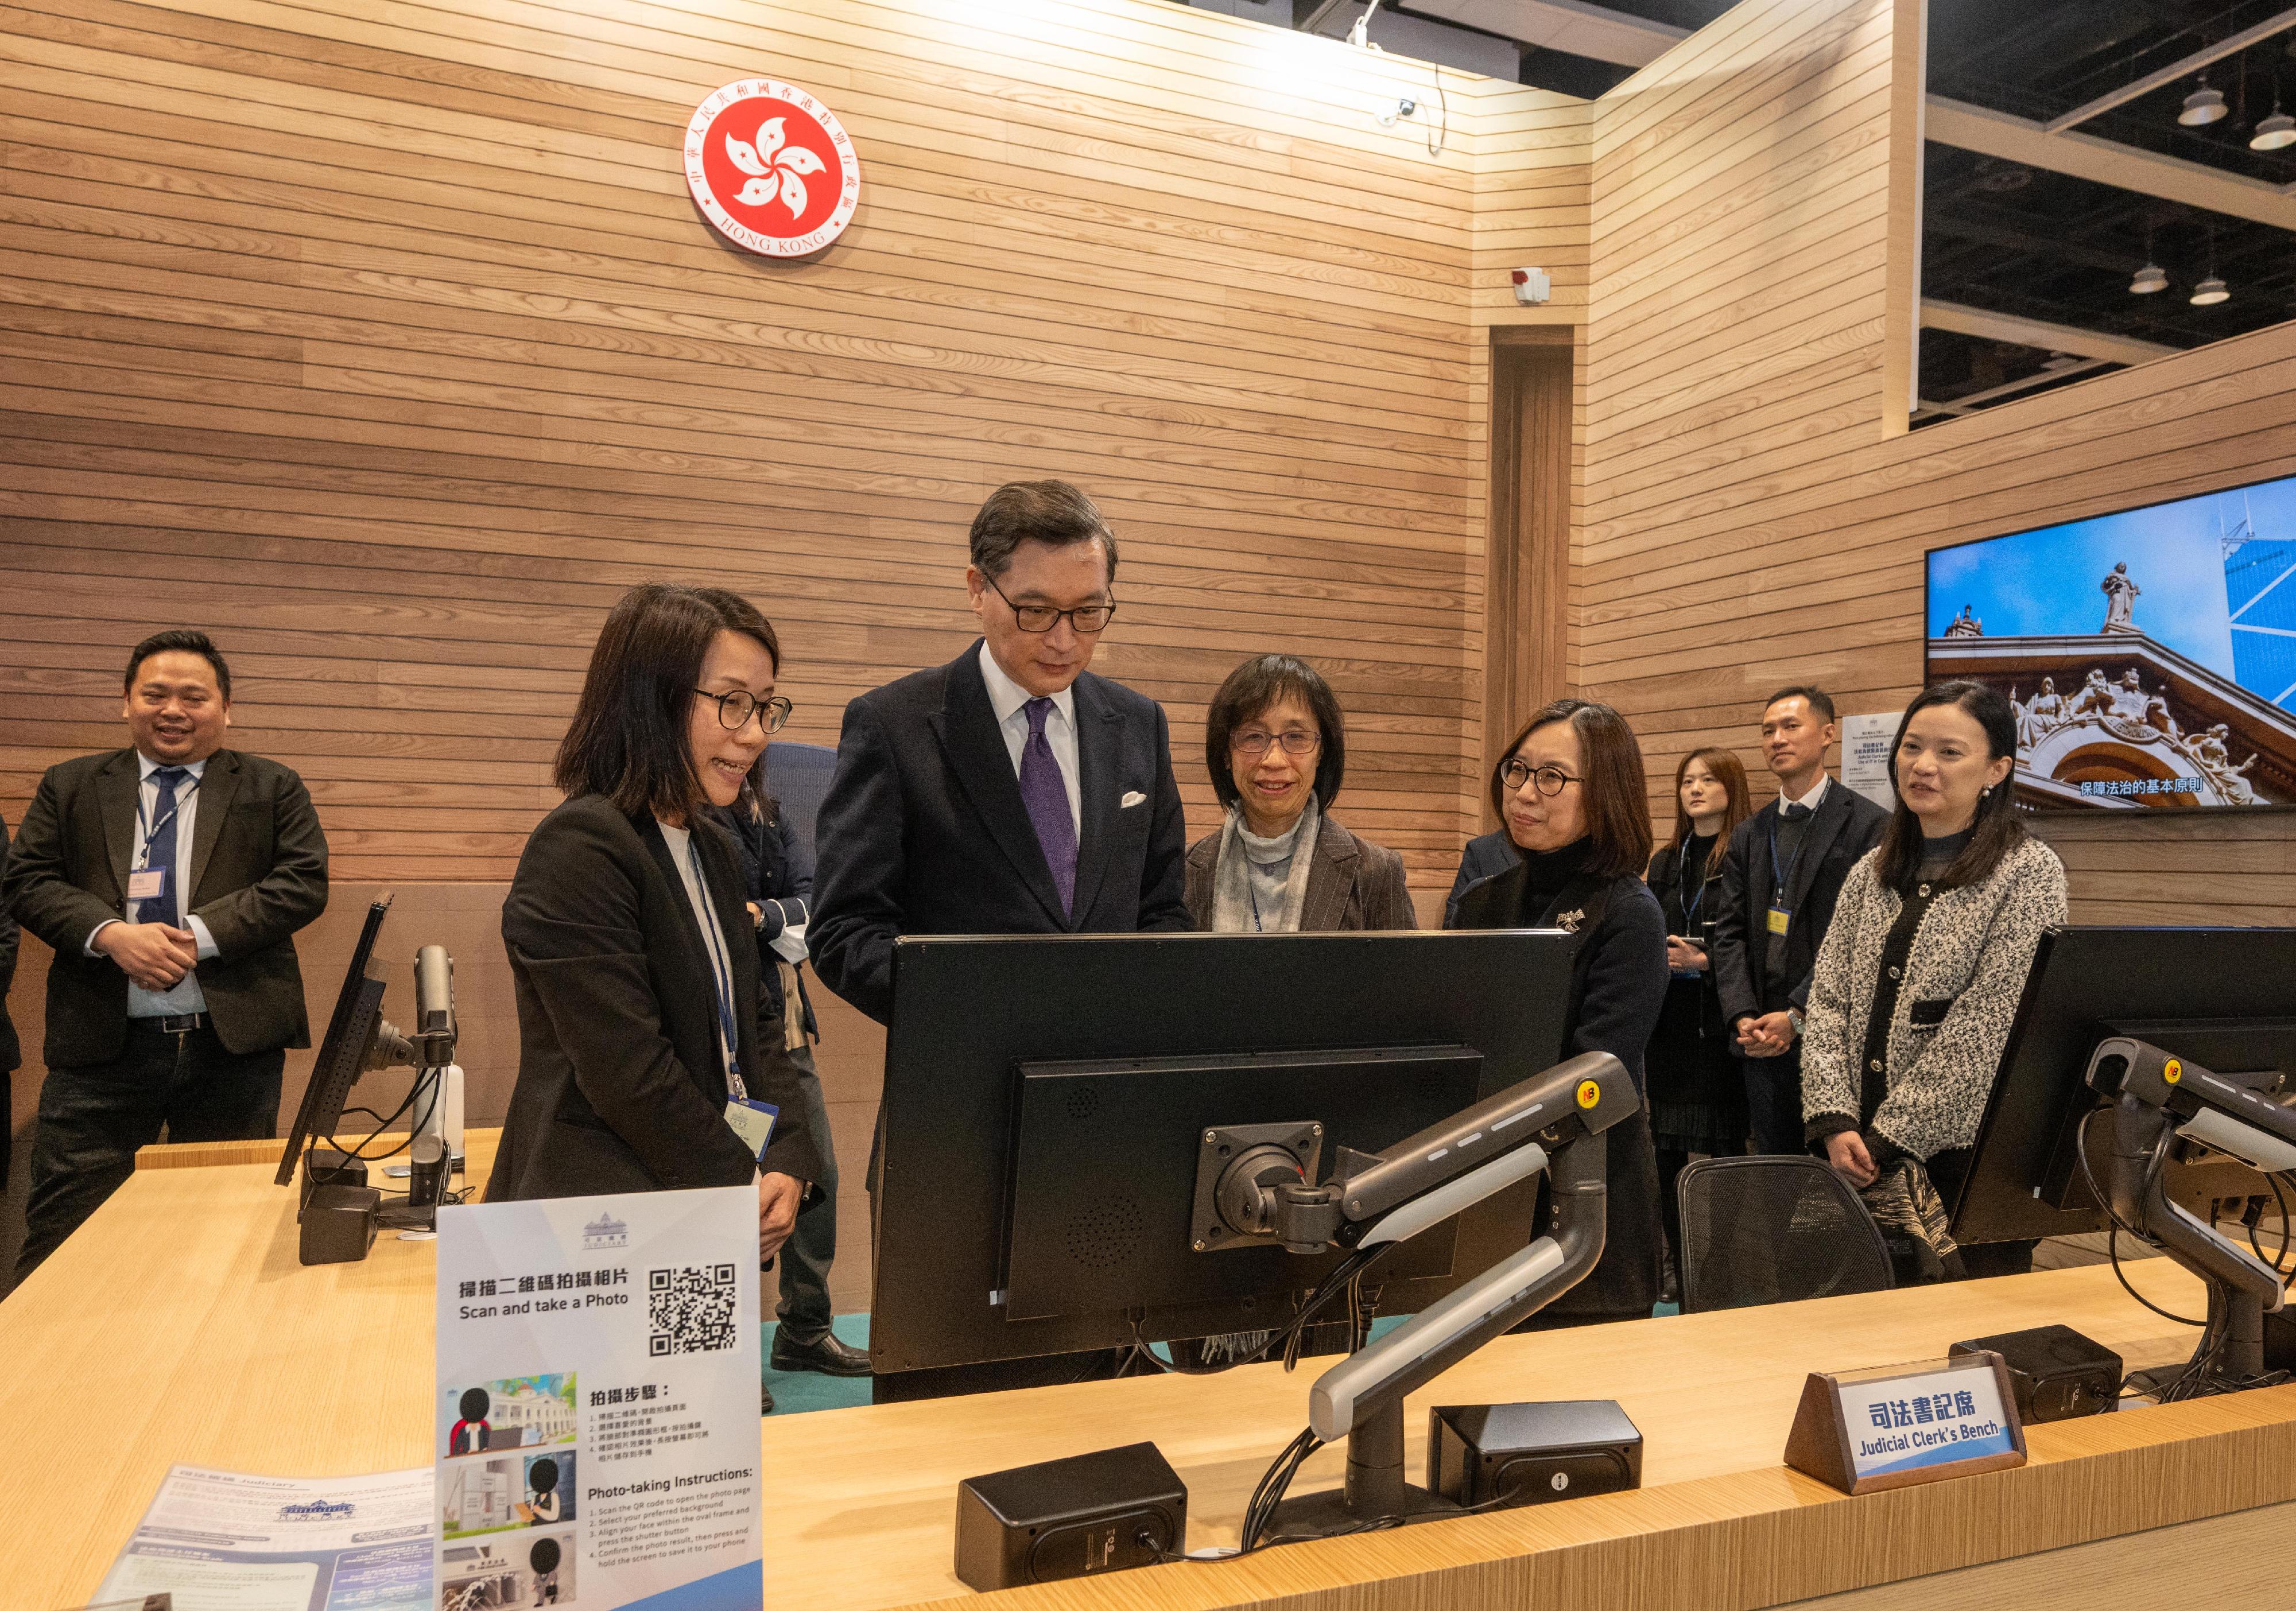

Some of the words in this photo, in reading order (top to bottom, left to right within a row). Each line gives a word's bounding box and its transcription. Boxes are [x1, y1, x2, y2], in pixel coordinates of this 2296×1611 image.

[687, 81, 858, 211] 中華人民共和國香港特別行政區
[721, 218, 770, 251] HONG
[779, 232, 825, 253] KONG
[2081, 777, 2202, 797] 保障法治的基本原則
[2168, 1066, 2178, 1077] NB
[1583, 1087, 1595, 1103] NB
[459, 1268, 629, 1299] 掃描二維碼拍攝相片
[460, 1305, 497, 1319] Scan
[503, 1302, 530, 1315] and
[535, 1297, 567, 1311] take
[573, 1299, 581, 1309] a
[586, 1292, 629, 1308] Photo
[1868, 1390, 1976, 1429] 司法書記席
[1859, 1434, 1910, 1457] Judicial
[1913, 1427, 1958, 1448] Clerk's
[1960, 1420, 1999, 1440] Bench
[239, 1479, 296, 1488] Judiciary
[588, 1480, 670, 1500] Photo-taking
[675, 1468, 753, 1488] Instructions:
[599, 1507, 616, 1515] Scan
[619, 1504, 631, 1512] the
[633, 1502, 645, 1511] QR
[646, 1499, 664, 1508] code
[676, 1494, 695, 1504] open
[696, 1492, 708, 1500] the
[710, 1489, 732, 1500] photo
[733, 1486, 751, 1496] page
[599, 1516, 622, 1526] Select
[624, 1514, 642, 1523] your
[643, 1507, 678, 1519] preferred
[680, 1501, 723, 1512] background
[598, 1528, 618, 1536] Align
[620, 1525, 637, 1534] your
[639, 1522, 655, 1530] face
[657, 1517, 680, 1527] within
[682, 1515, 694, 1523] the
[696, 1512, 711, 1521] oval
[713, 1510, 734, 1518] frame
[736, 1507, 750, 1515] and
[598, 1539, 619, 1548] press
[635, 1531, 663, 1541] shutter
[664, 1527, 689, 1536] button
[598, 1547, 630, 1558] Confirm
[631, 1544, 643, 1552] the
[645, 1540, 668, 1551] photo
[669, 1536, 693, 1546] result,
[695, 1534, 712, 1542] then
[713, 1531, 733, 1540] press
[735, 1526, 749, 1535] and
[598, 1558, 616, 1568] hold
[618, 1556, 630, 1565] the
[632, 1553, 657, 1563] screen
[669, 1548, 685, 1556] save
[704, 1542, 721, 1552] your
[722, 1538, 746, 1548] phone
